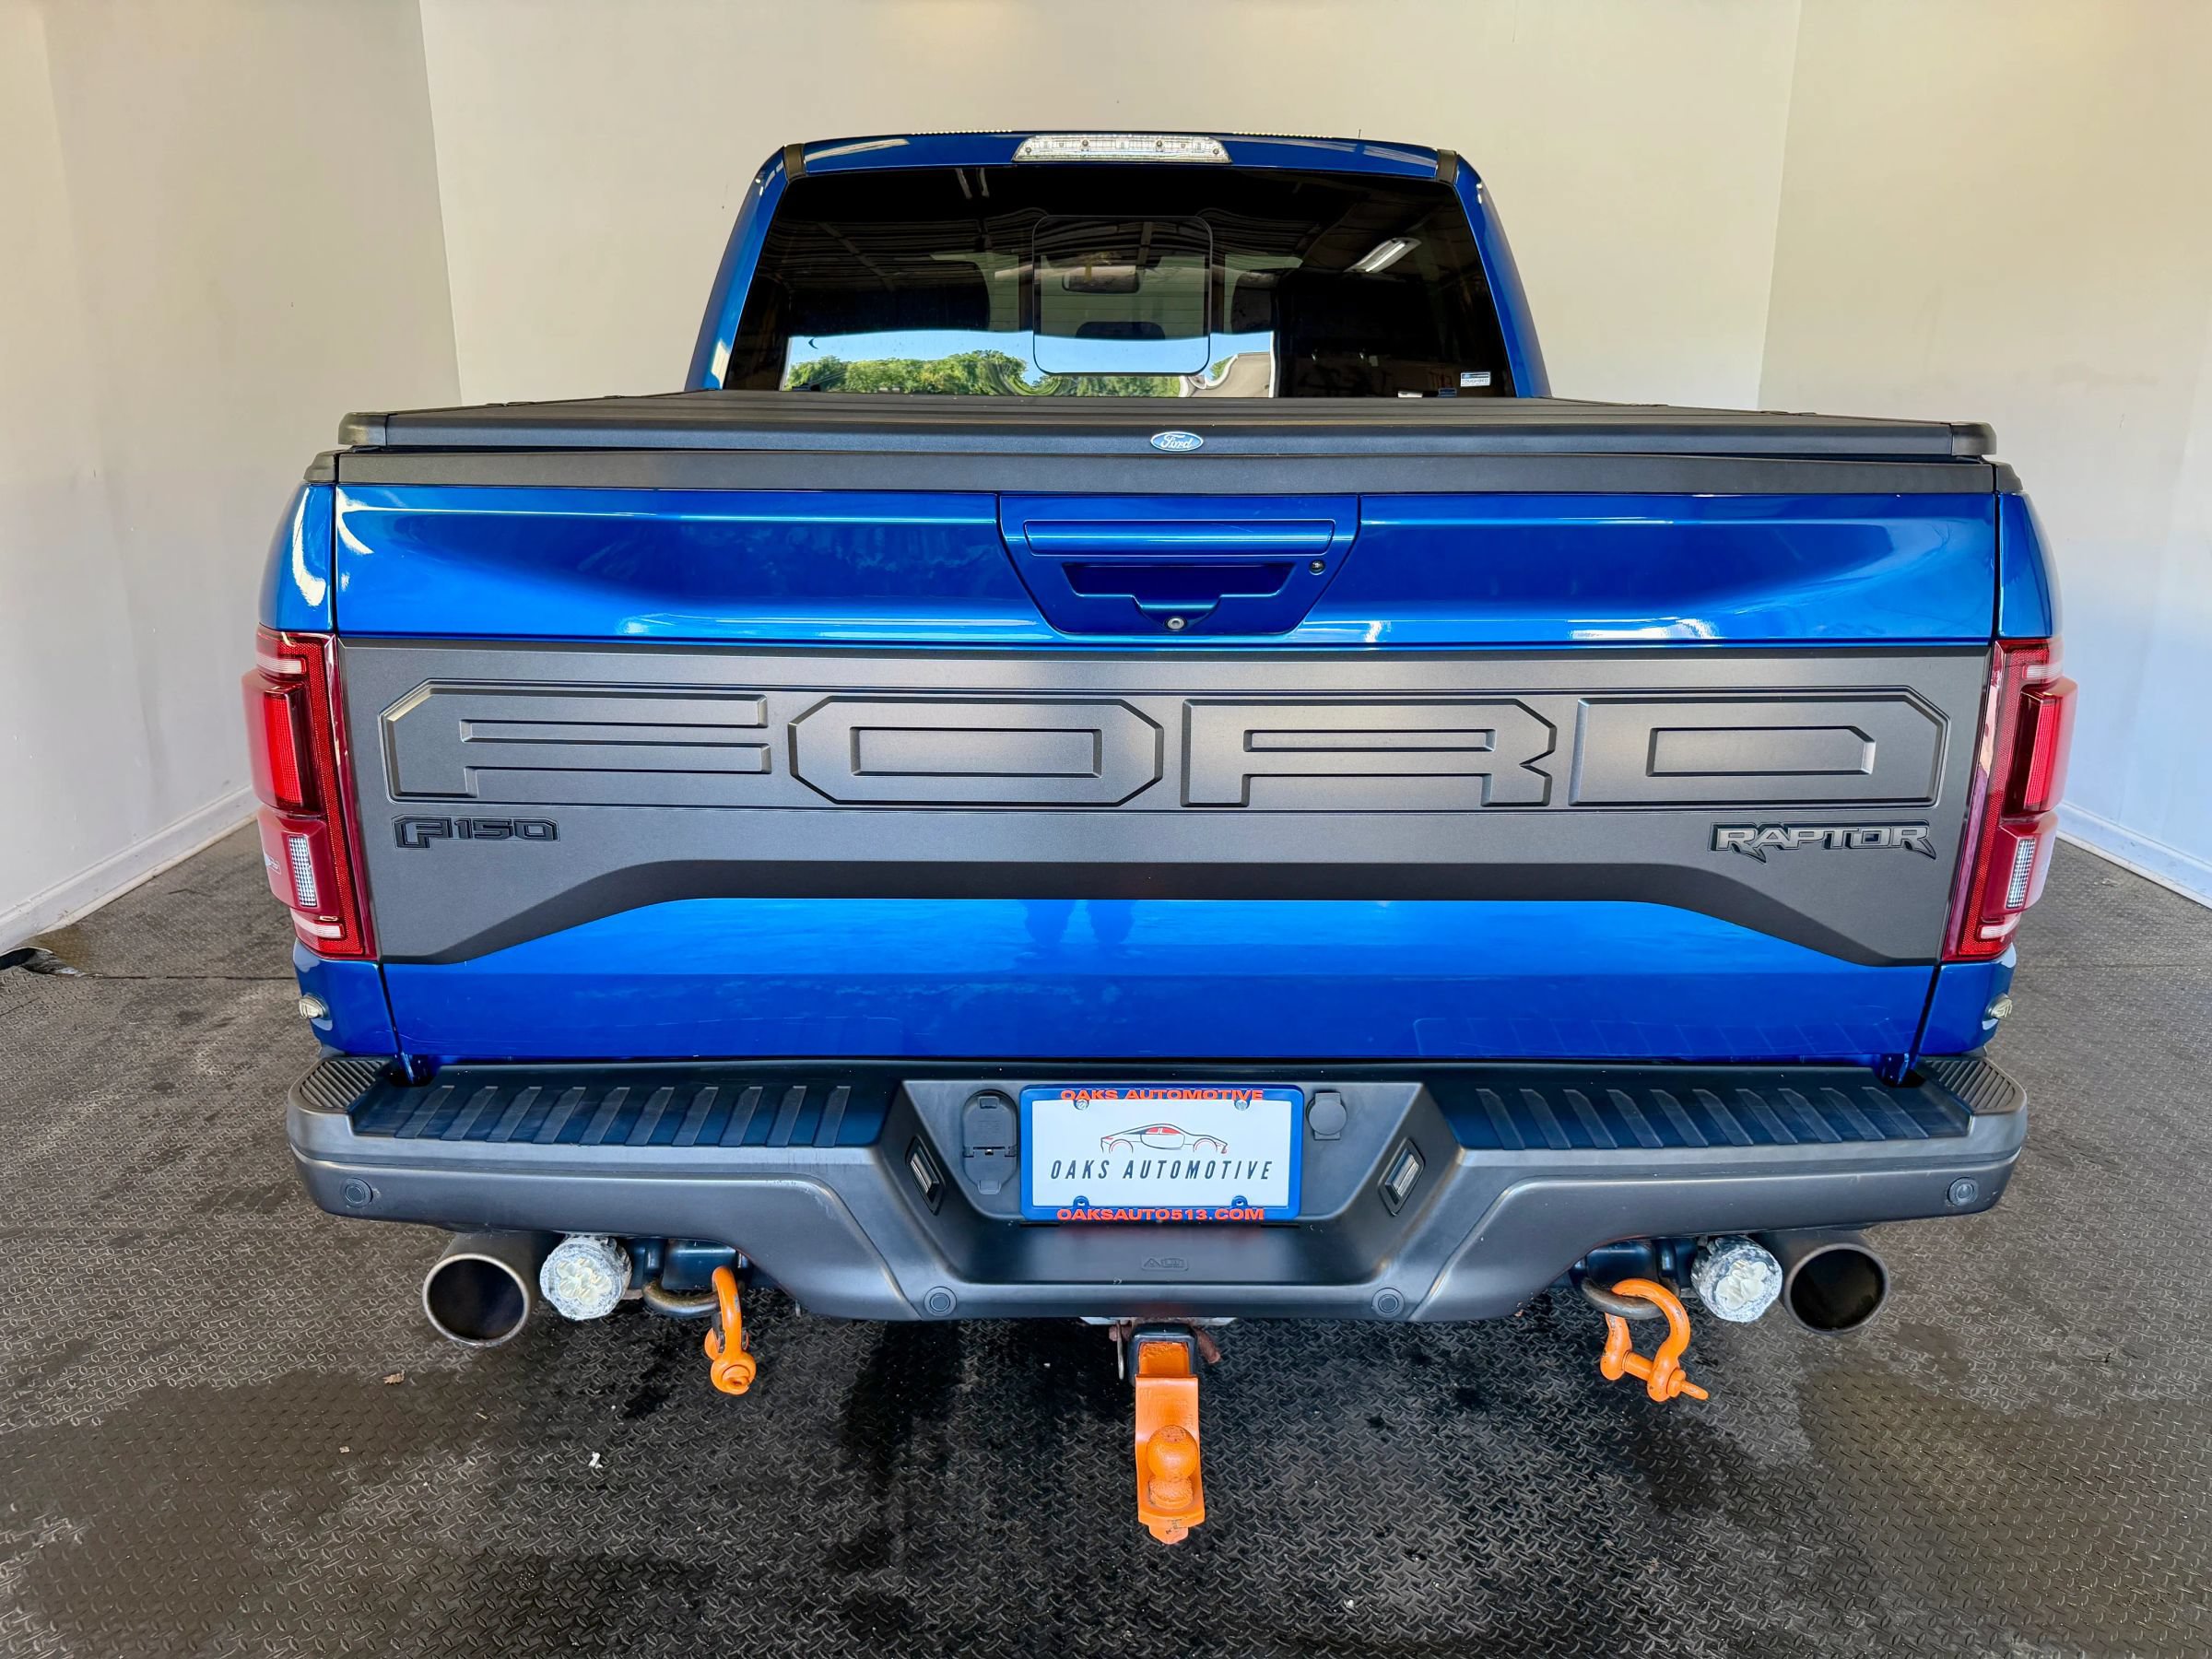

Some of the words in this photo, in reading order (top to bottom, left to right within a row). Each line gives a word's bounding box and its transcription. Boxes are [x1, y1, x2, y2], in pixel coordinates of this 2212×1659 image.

[1160, 433, 1194, 449] Ford
[380, 678, 1948, 810] FORD
[1710, 820, 1936, 863] RAPTOR
[1061, 1089, 1118, 1100] OAKS
[1124, 1089, 1264, 1100] AUTOMOTIVE
[1051, 1159, 1109, 1180] OAKS
[1123, 1159, 1272, 1180] AUTOMOTIVE
[1056, 1208, 1265, 1220] OAKSAUTO513.COM
